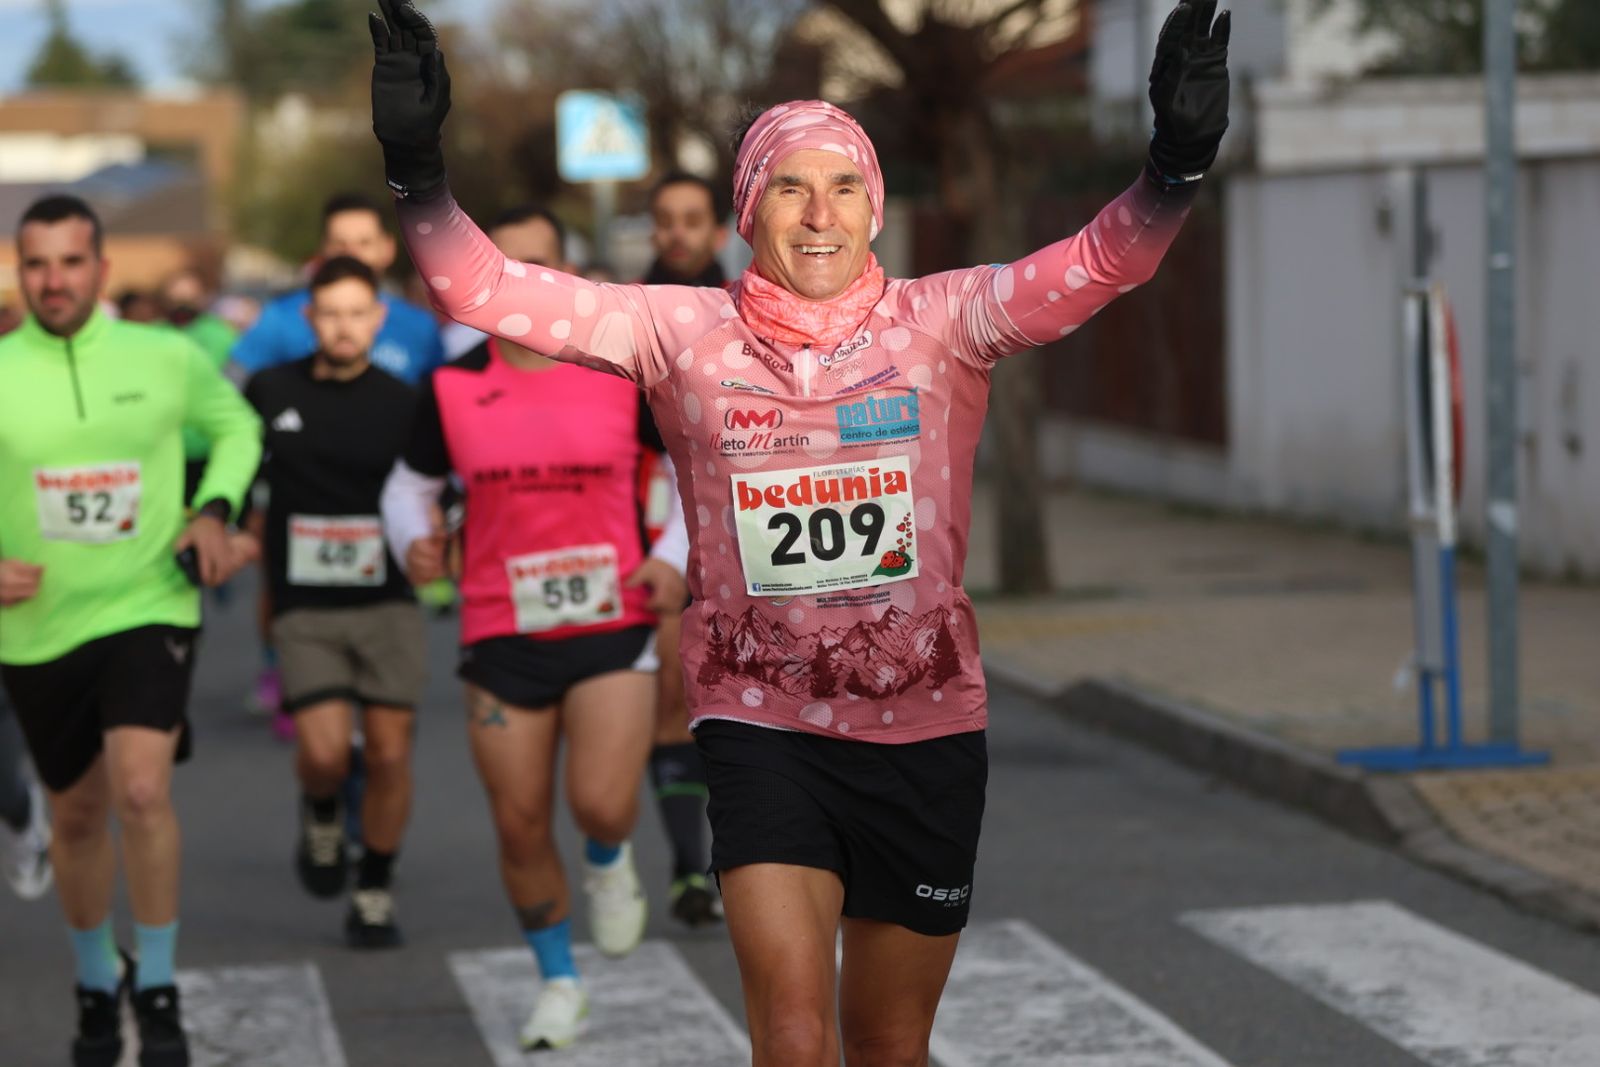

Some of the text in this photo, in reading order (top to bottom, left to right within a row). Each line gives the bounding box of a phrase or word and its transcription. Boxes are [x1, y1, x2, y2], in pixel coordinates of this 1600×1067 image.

[825, 360, 866, 384] TEAM
[747, 432, 810, 450] Martín
[840, 430, 872, 440] centro
[875, 427, 888, 437] de
[813, 465, 865, 478] FLORISTERÍAS
[736, 467, 908, 511] bedunia
[66, 491, 114, 524] 52
[767, 502, 885, 566] 209
[543, 576, 589, 610] 58
